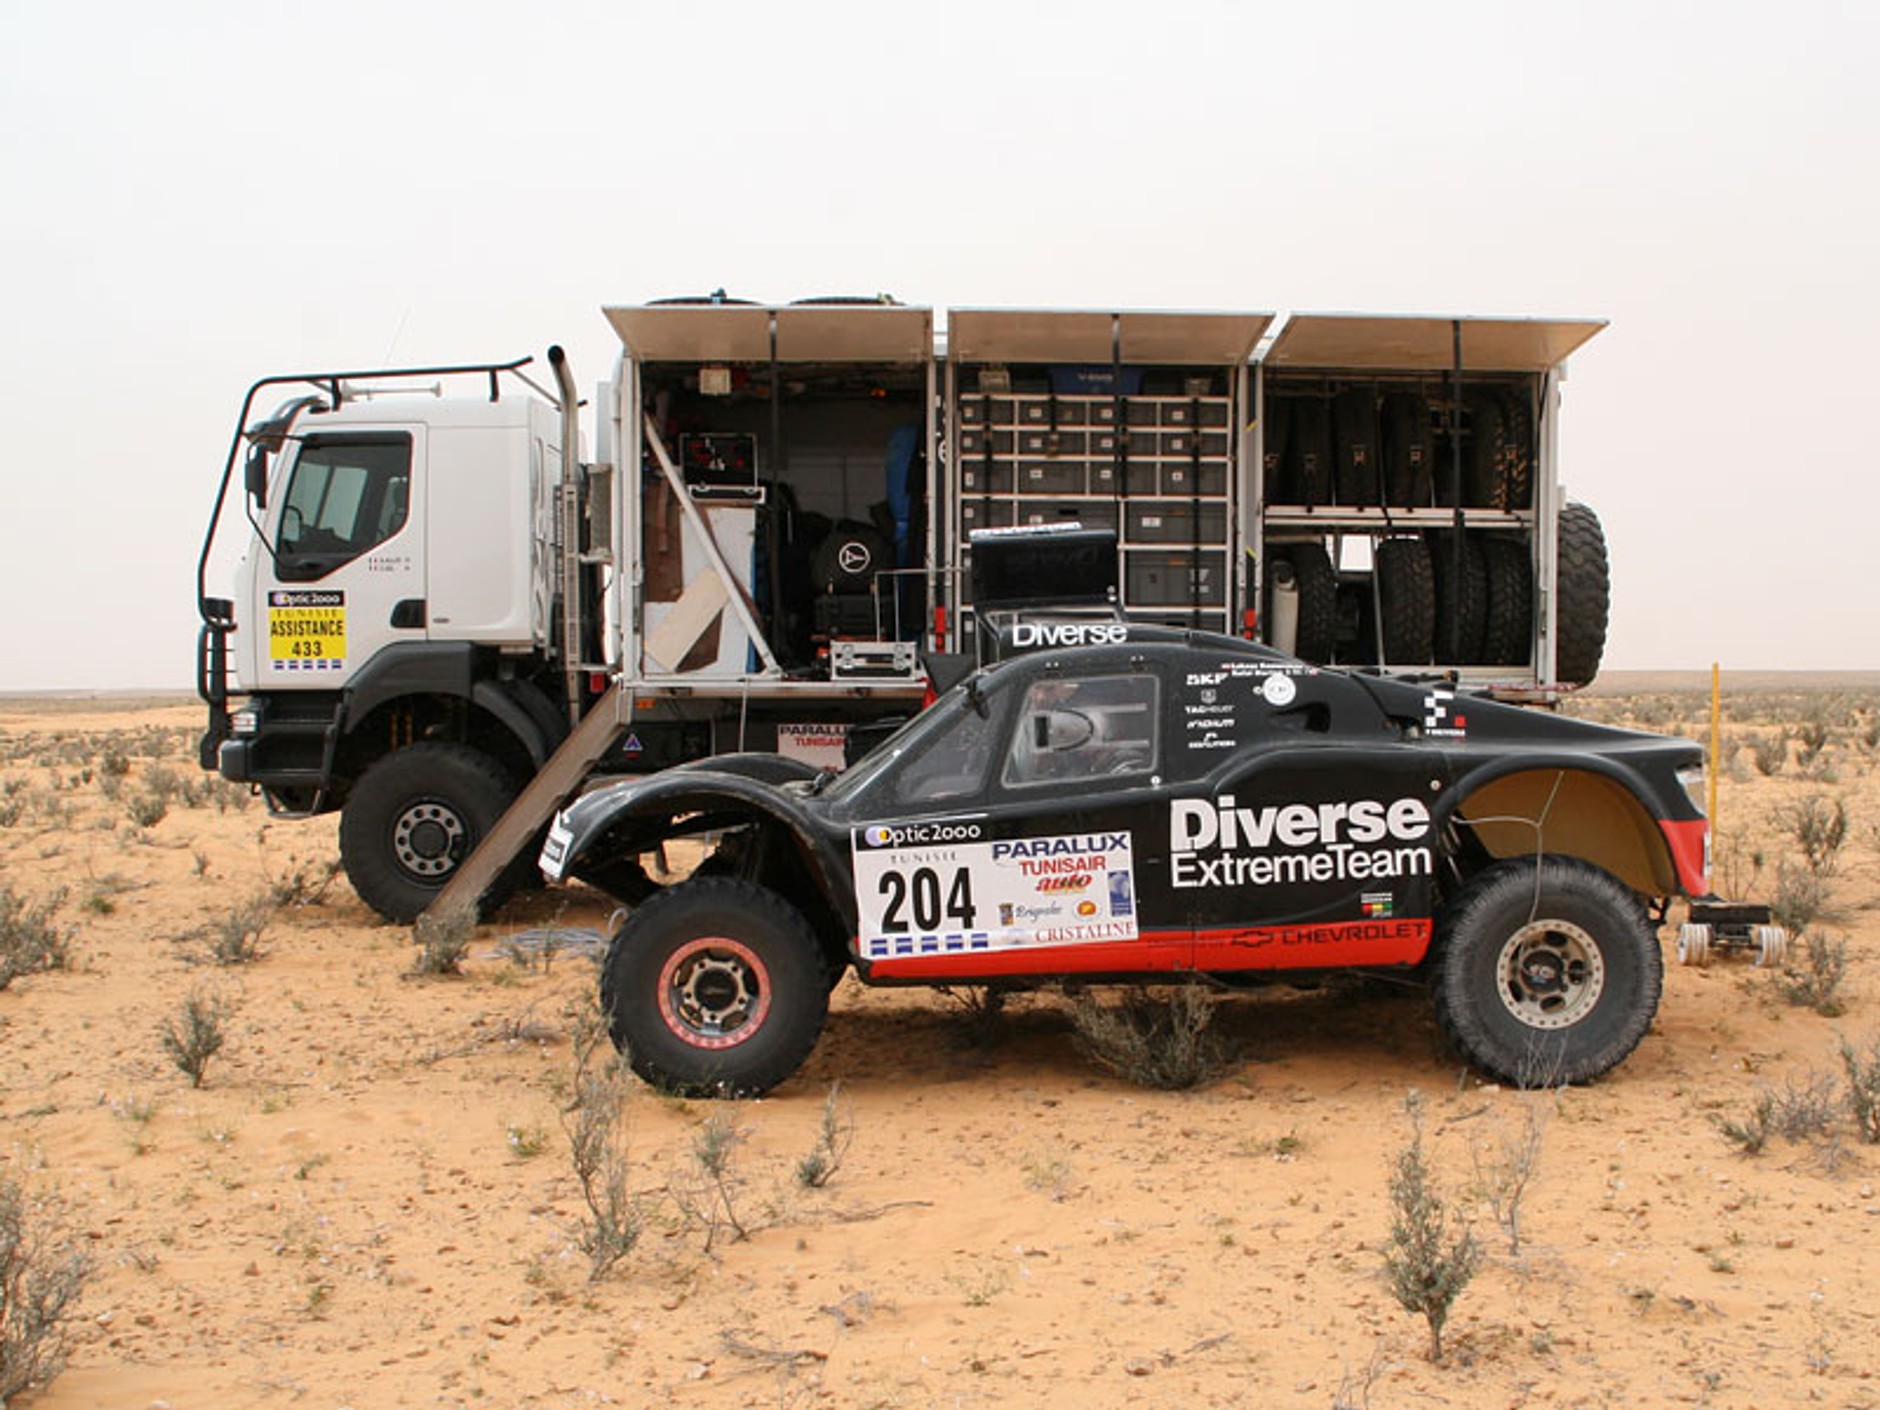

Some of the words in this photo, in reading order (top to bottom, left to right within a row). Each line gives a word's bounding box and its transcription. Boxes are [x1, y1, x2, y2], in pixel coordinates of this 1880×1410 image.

[270, 620, 344, 636] ASSISTANCE
[1012, 622, 1128, 647] Diverse
[291, 641, 323, 657] 433
[1186, 672, 1229, 686] SKF
[1170, 795, 1430, 852] Diverse
[865, 824, 982, 848] Optic2000
[992, 834, 1130, 860] PARALUX
[1020, 855, 1107, 876] TUNISAIR
[1171, 844, 1432, 888] ExtremeTeam
[878, 866, 977, 934] 204
[1035, 921, 1135, 943] CRISTALINE
[1282, 921, 1428, 945] CHEVROLET
